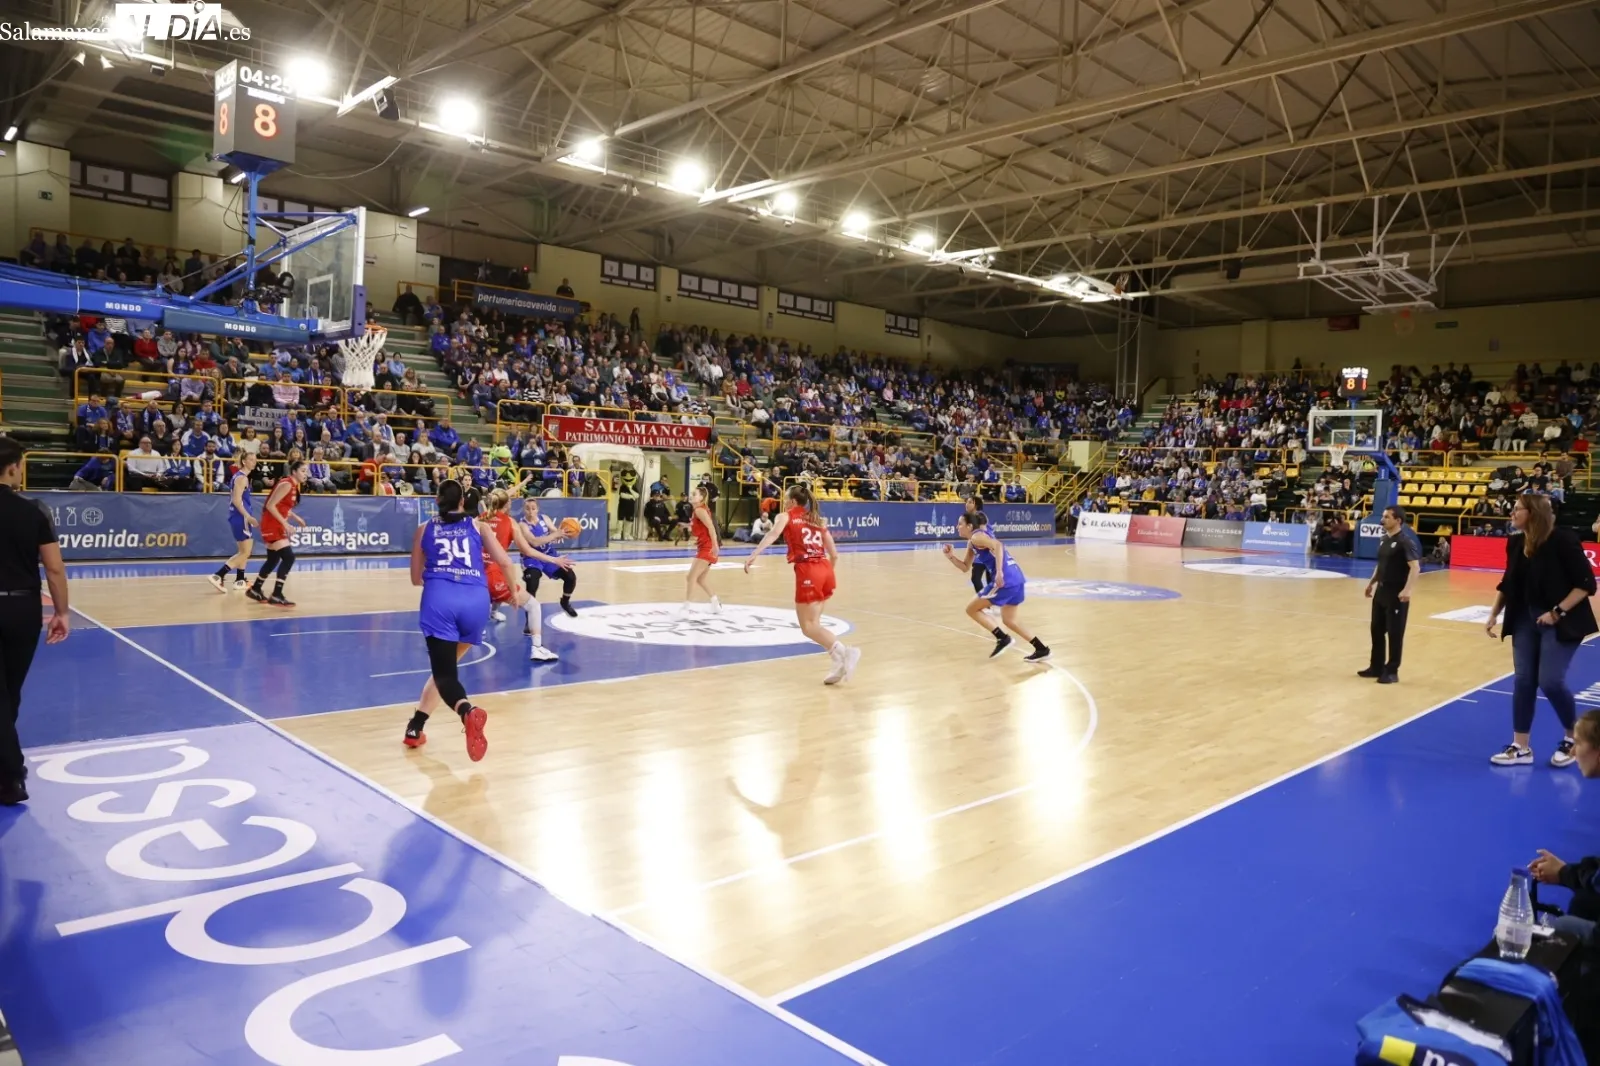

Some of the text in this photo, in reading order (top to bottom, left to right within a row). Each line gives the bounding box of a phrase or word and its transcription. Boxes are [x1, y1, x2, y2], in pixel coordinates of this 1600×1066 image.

[220, 102, 228, 135] 8
[254, 103, 277, 138] 8
[105, 302, 142, 312] MONDO
[224, 322, 257, 333] MONDO
[1346, 378, 1355, 390] 8
[584, 420, 695, 438] SALAMANCA
[565, 431, 708, 449] PATRIMONIO DE LA HUMANIDAD
[847, 516, 855, 529] Y
[856, 513, 880, 527] LEÓN
[1100, 520, 1127, 529] GANSO
[801, 527, 824, 547] 24
[434, 537, 472, 568] 34
